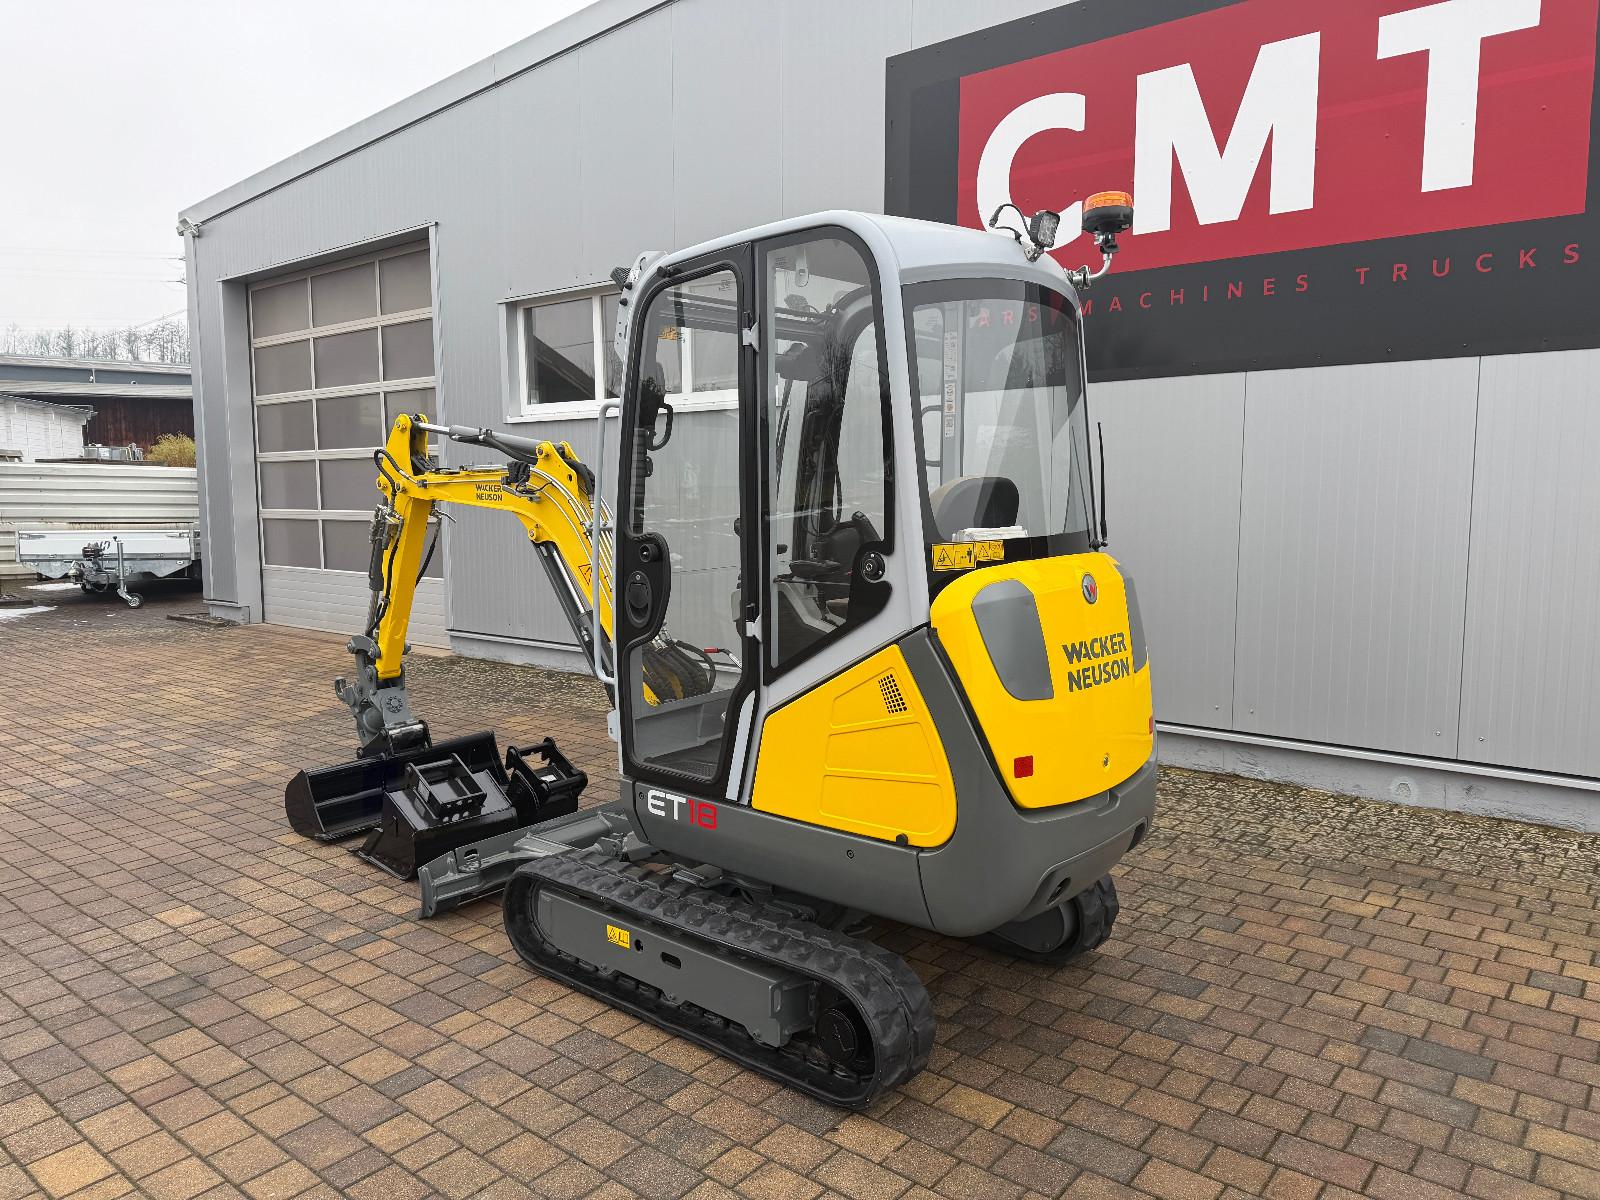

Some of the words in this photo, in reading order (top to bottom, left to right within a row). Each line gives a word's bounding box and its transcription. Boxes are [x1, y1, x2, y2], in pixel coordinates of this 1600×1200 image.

[976, 0, 1541, 252] CMT
[1079, 274, 1308, 316] MACHINES
[1355, 243, 1580, 285] TRUCKS
[476, 484, 502, 492] WACKER
[476, 493, 503, 501] NEUSON
[1062, 632, 1127, 664] WACKER
[1067, 657, 1130, 692] NEUSON
[648, 789, 718, 831] ET18
